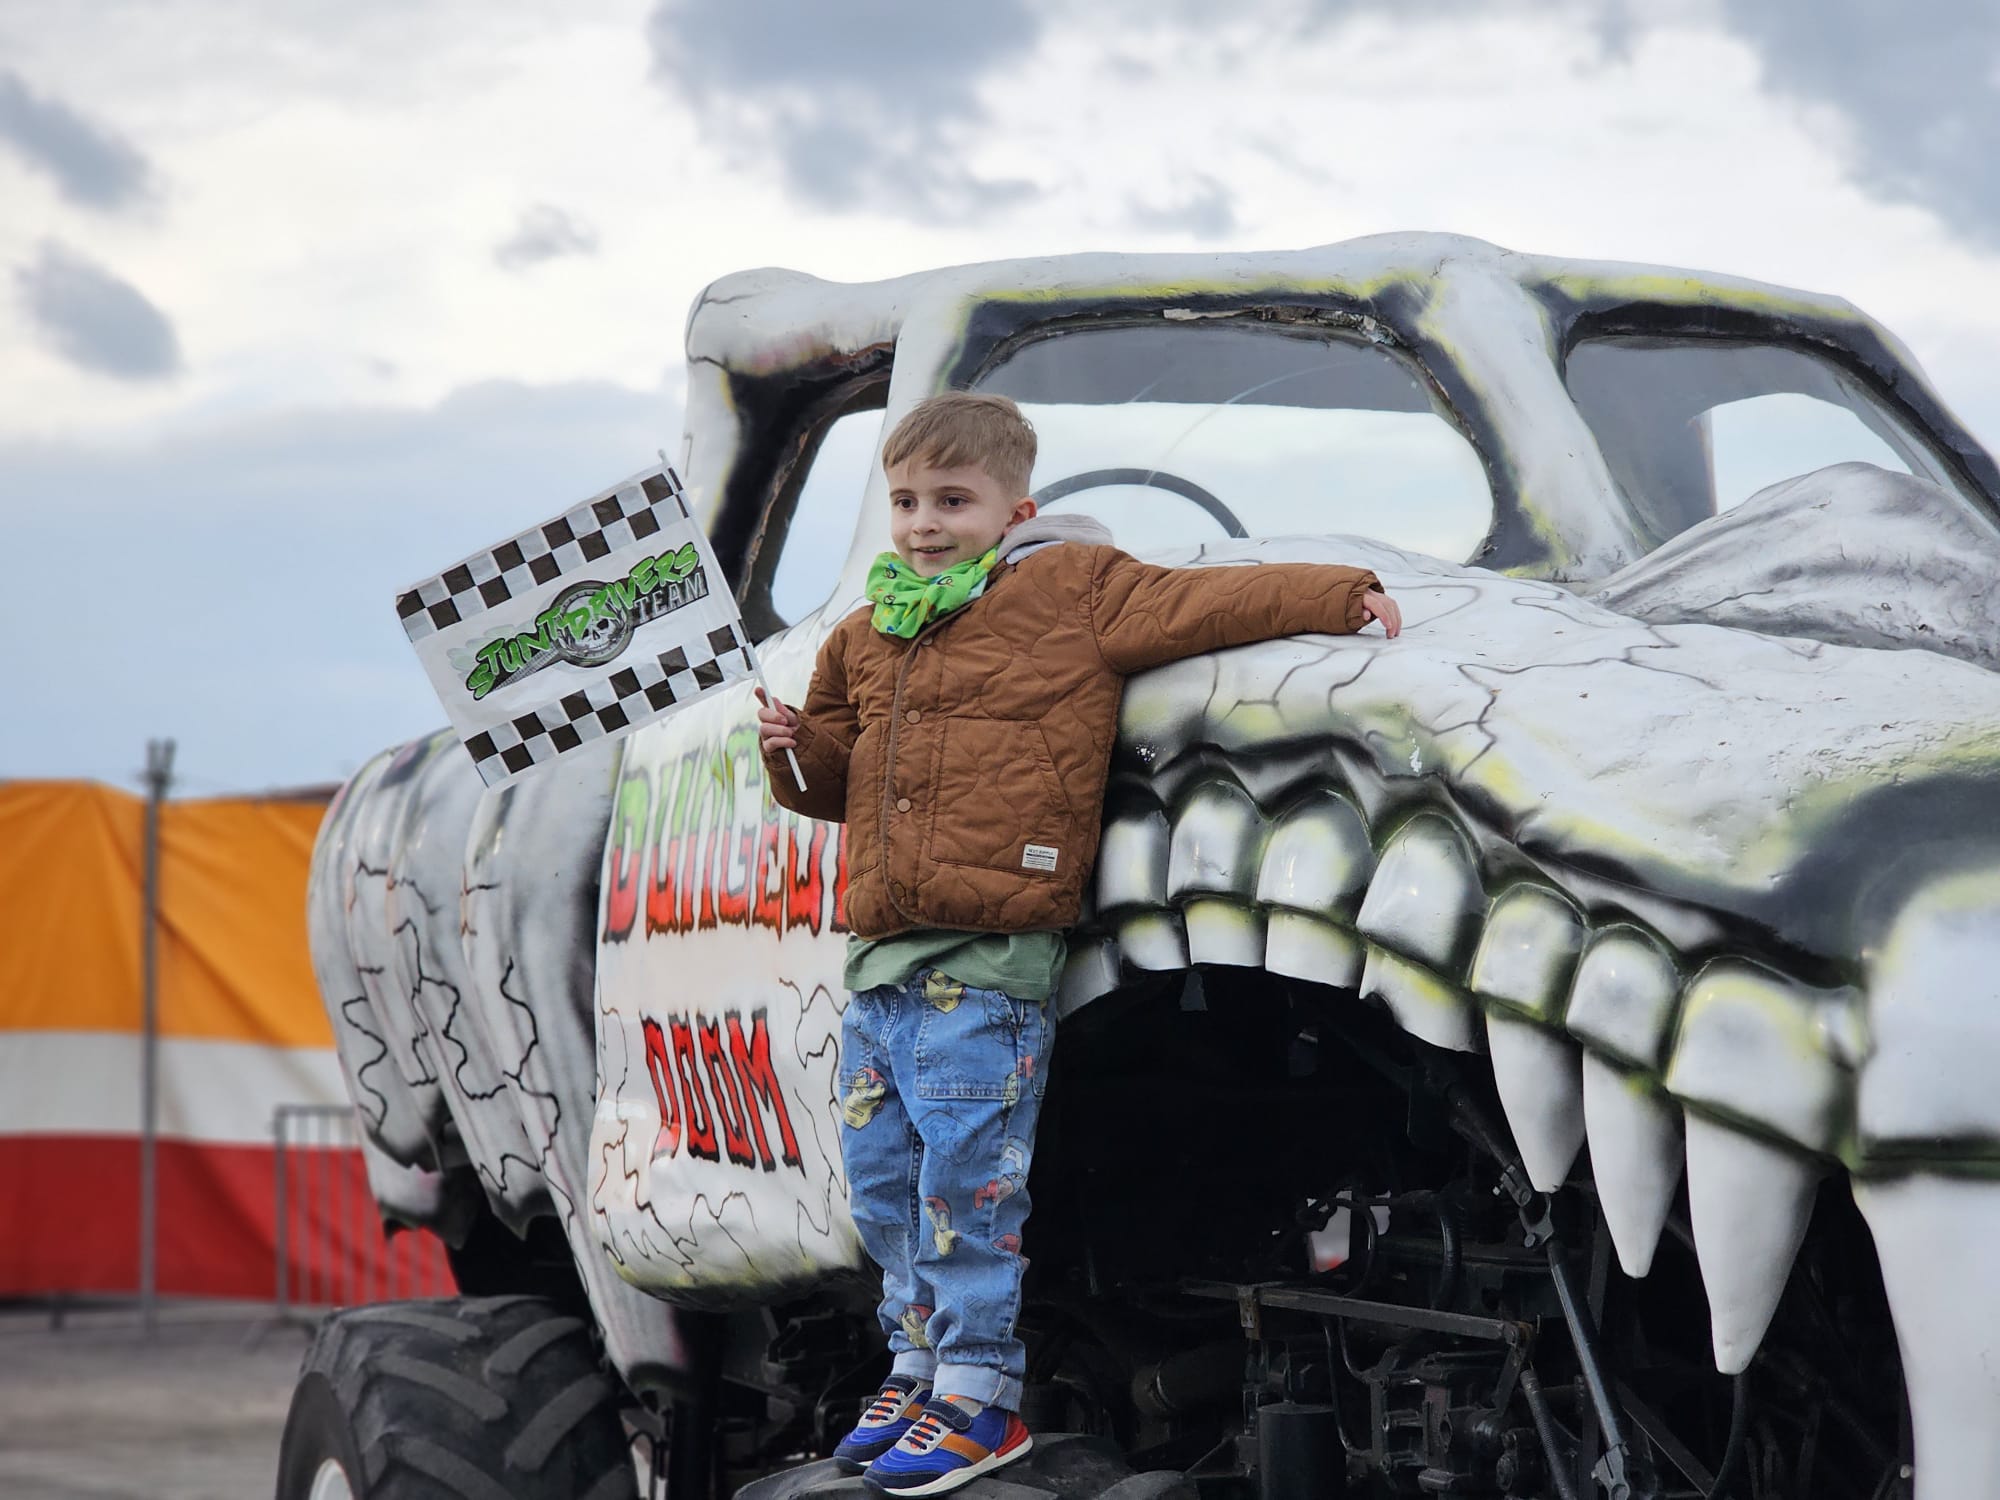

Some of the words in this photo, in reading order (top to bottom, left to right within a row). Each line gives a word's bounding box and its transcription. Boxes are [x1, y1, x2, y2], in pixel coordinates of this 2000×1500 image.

[634, 571, 708, 625] TEAM
[602, 722, 850, 945] DUNGEO
[639, 1006, 806, 1178] DOOM
